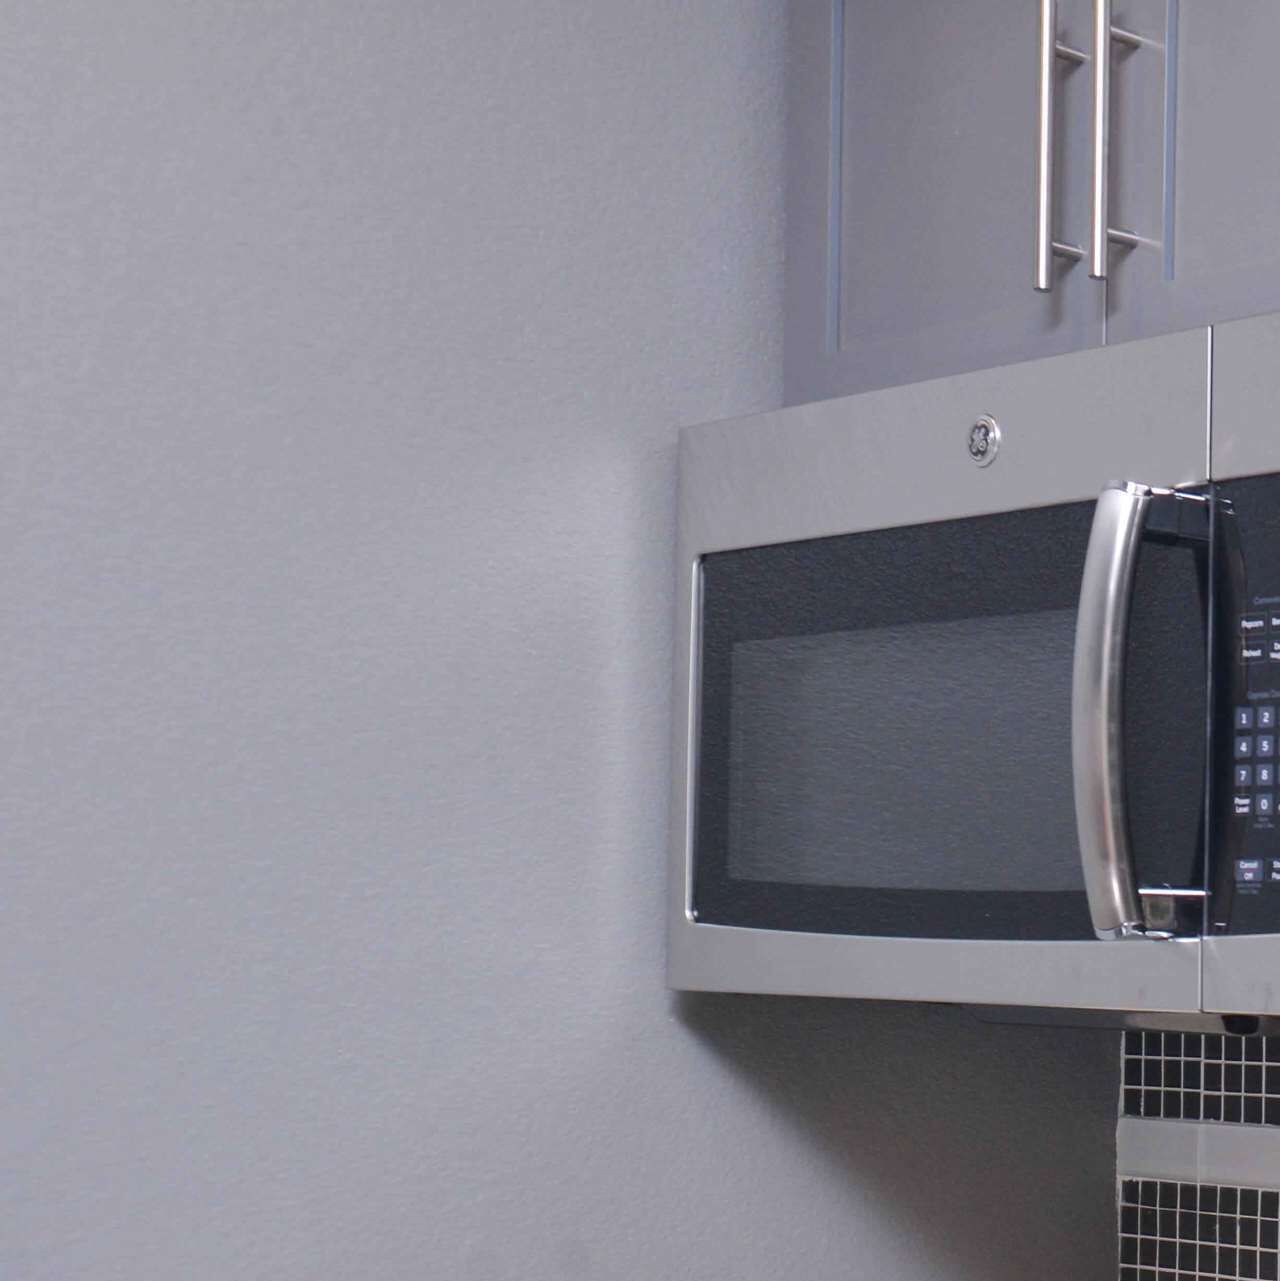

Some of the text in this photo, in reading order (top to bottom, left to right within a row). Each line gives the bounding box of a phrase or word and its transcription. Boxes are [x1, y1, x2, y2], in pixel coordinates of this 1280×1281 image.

[1241, 713, 1247, 724] 1
[1262, 712, 1269, 723] 2
[1240, 742, 1247, 752] 4
[1262, 740, 1269, 751] 5
[1240, 770, 1247, 781] 7
[1261, 769, 1268, 780] 8
[1260, 799, 1268, 810] 0
